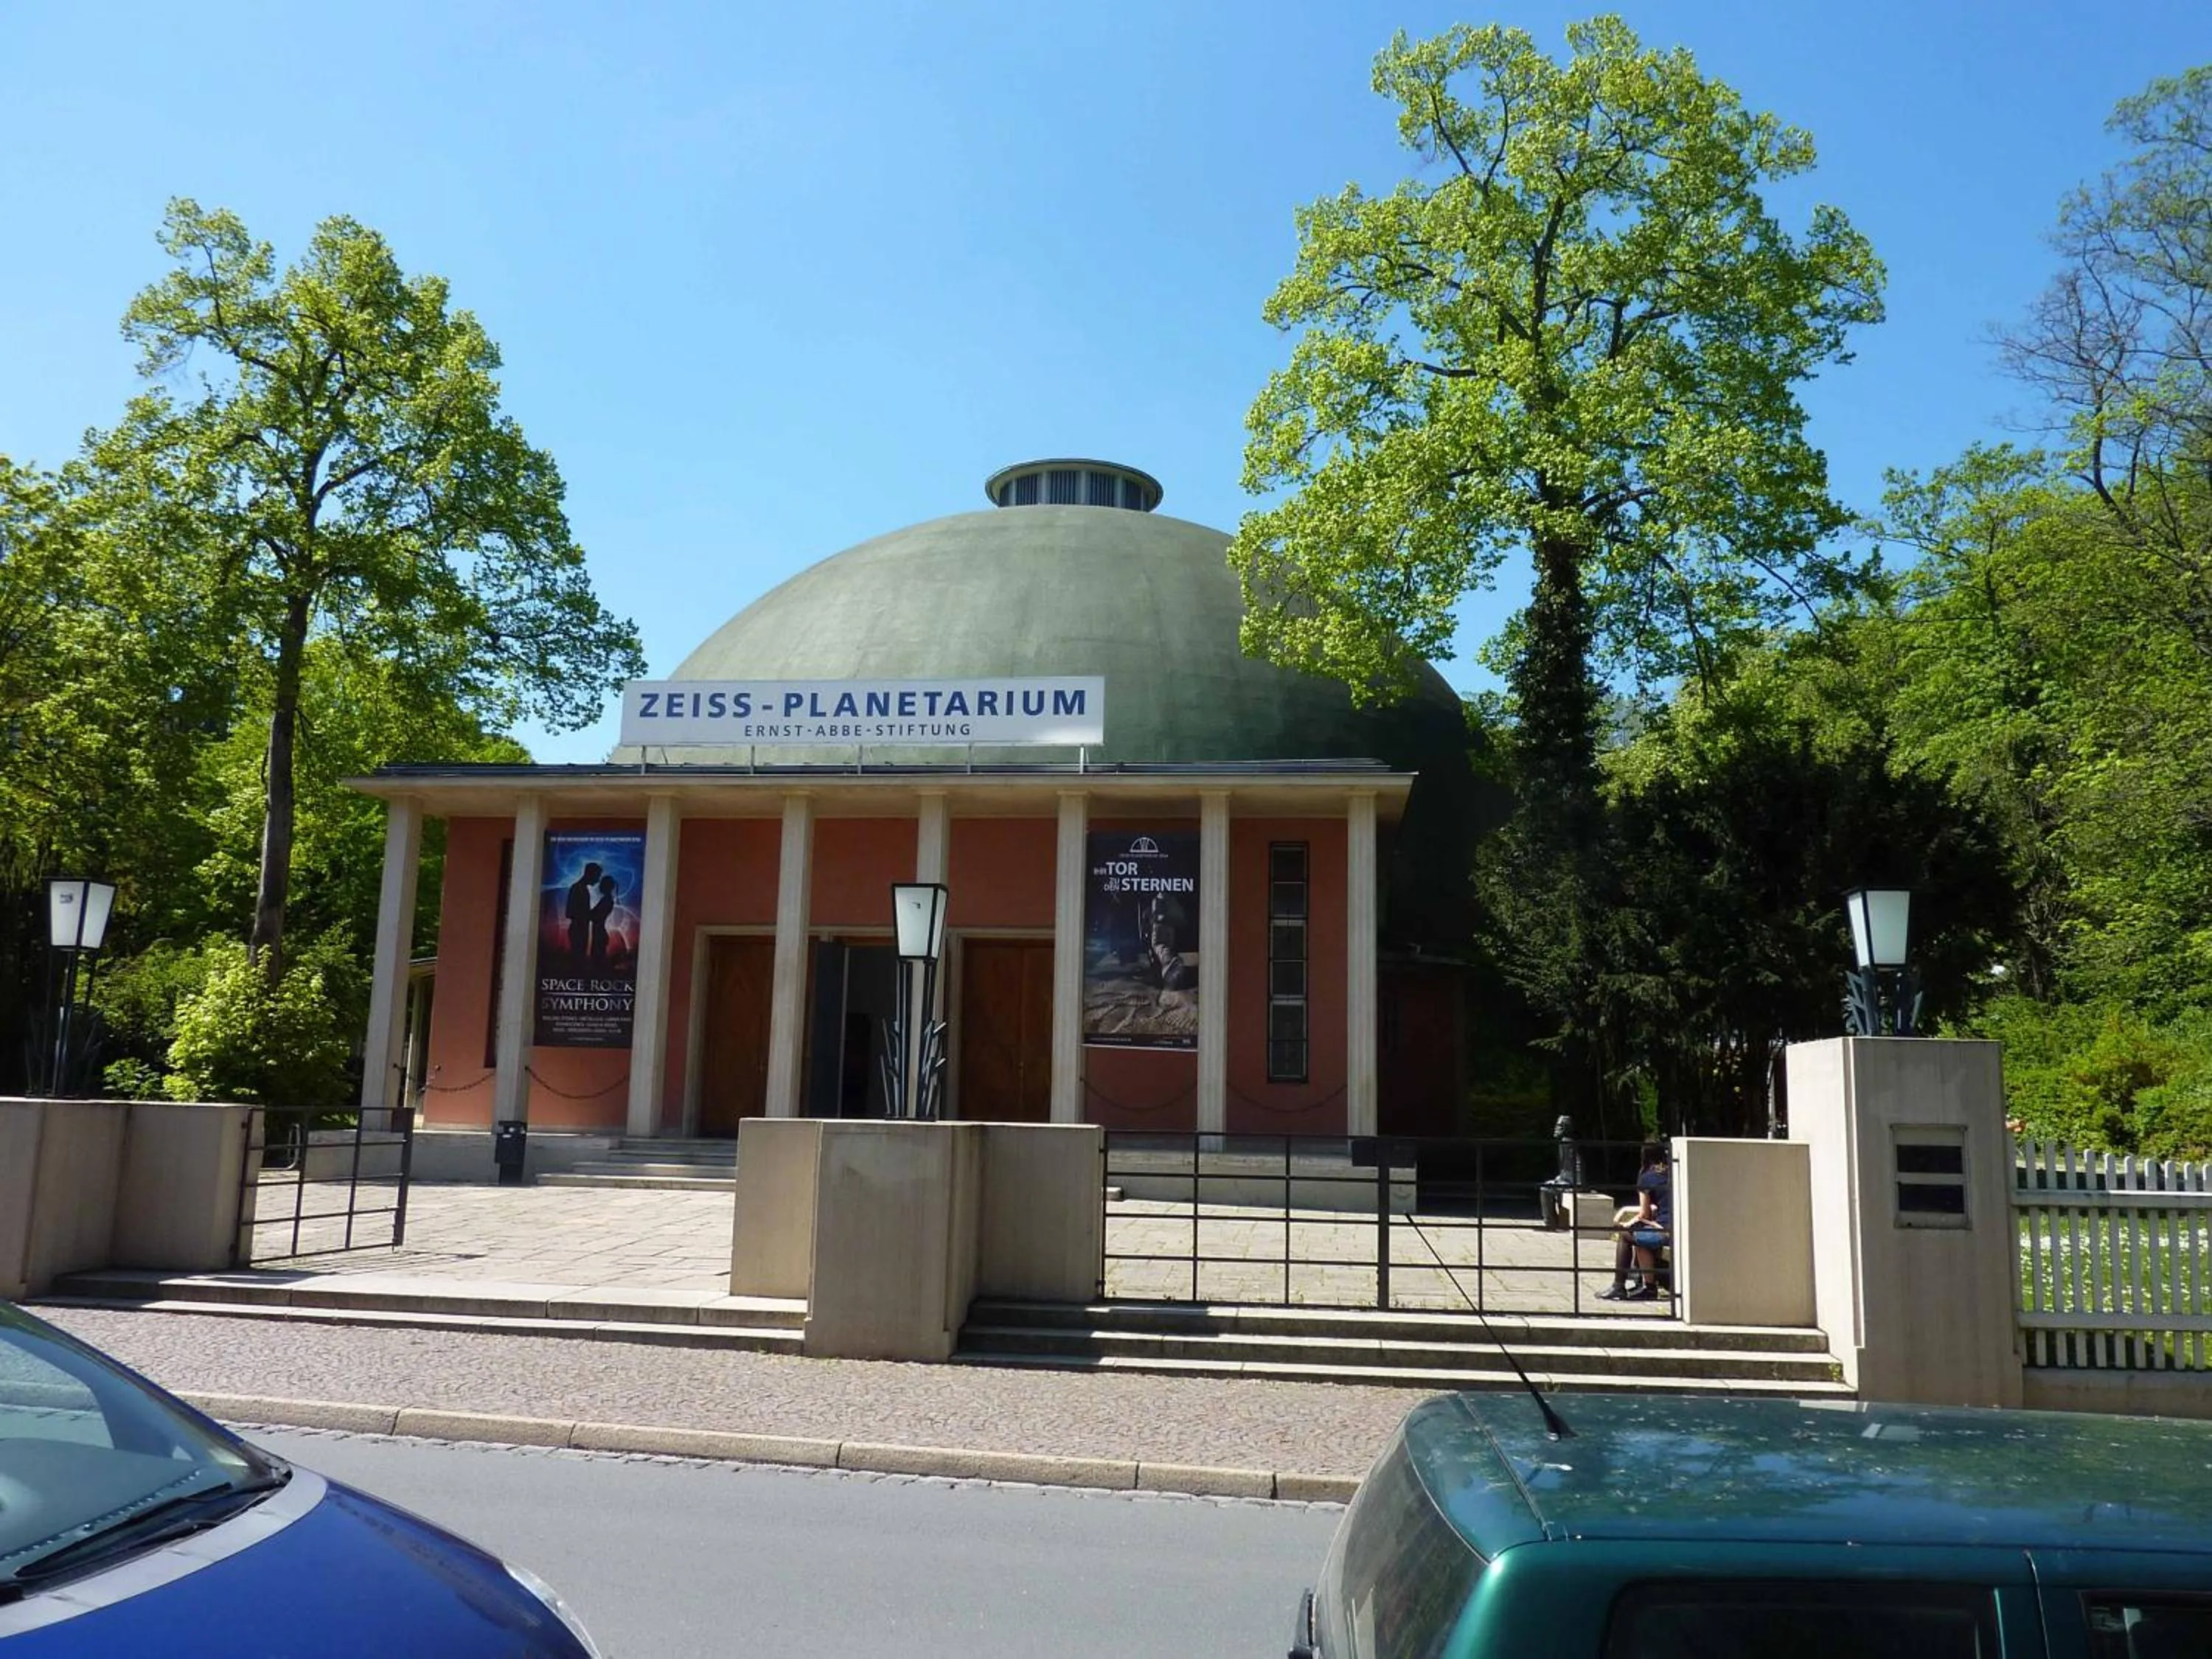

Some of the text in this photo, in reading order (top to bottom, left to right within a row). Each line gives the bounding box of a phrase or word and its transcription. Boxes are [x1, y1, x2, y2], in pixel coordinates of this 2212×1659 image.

[744, 723, 971, 737] ERNST-ABBE-STIFTUNG
[1106, 862, 1138, 875] TOR
[1121, 877, 1194, 891] STERNEN
[542, 978, 635, 992] SPACE ROCK
[542, 997, 633, 1011] SYMPHONY
